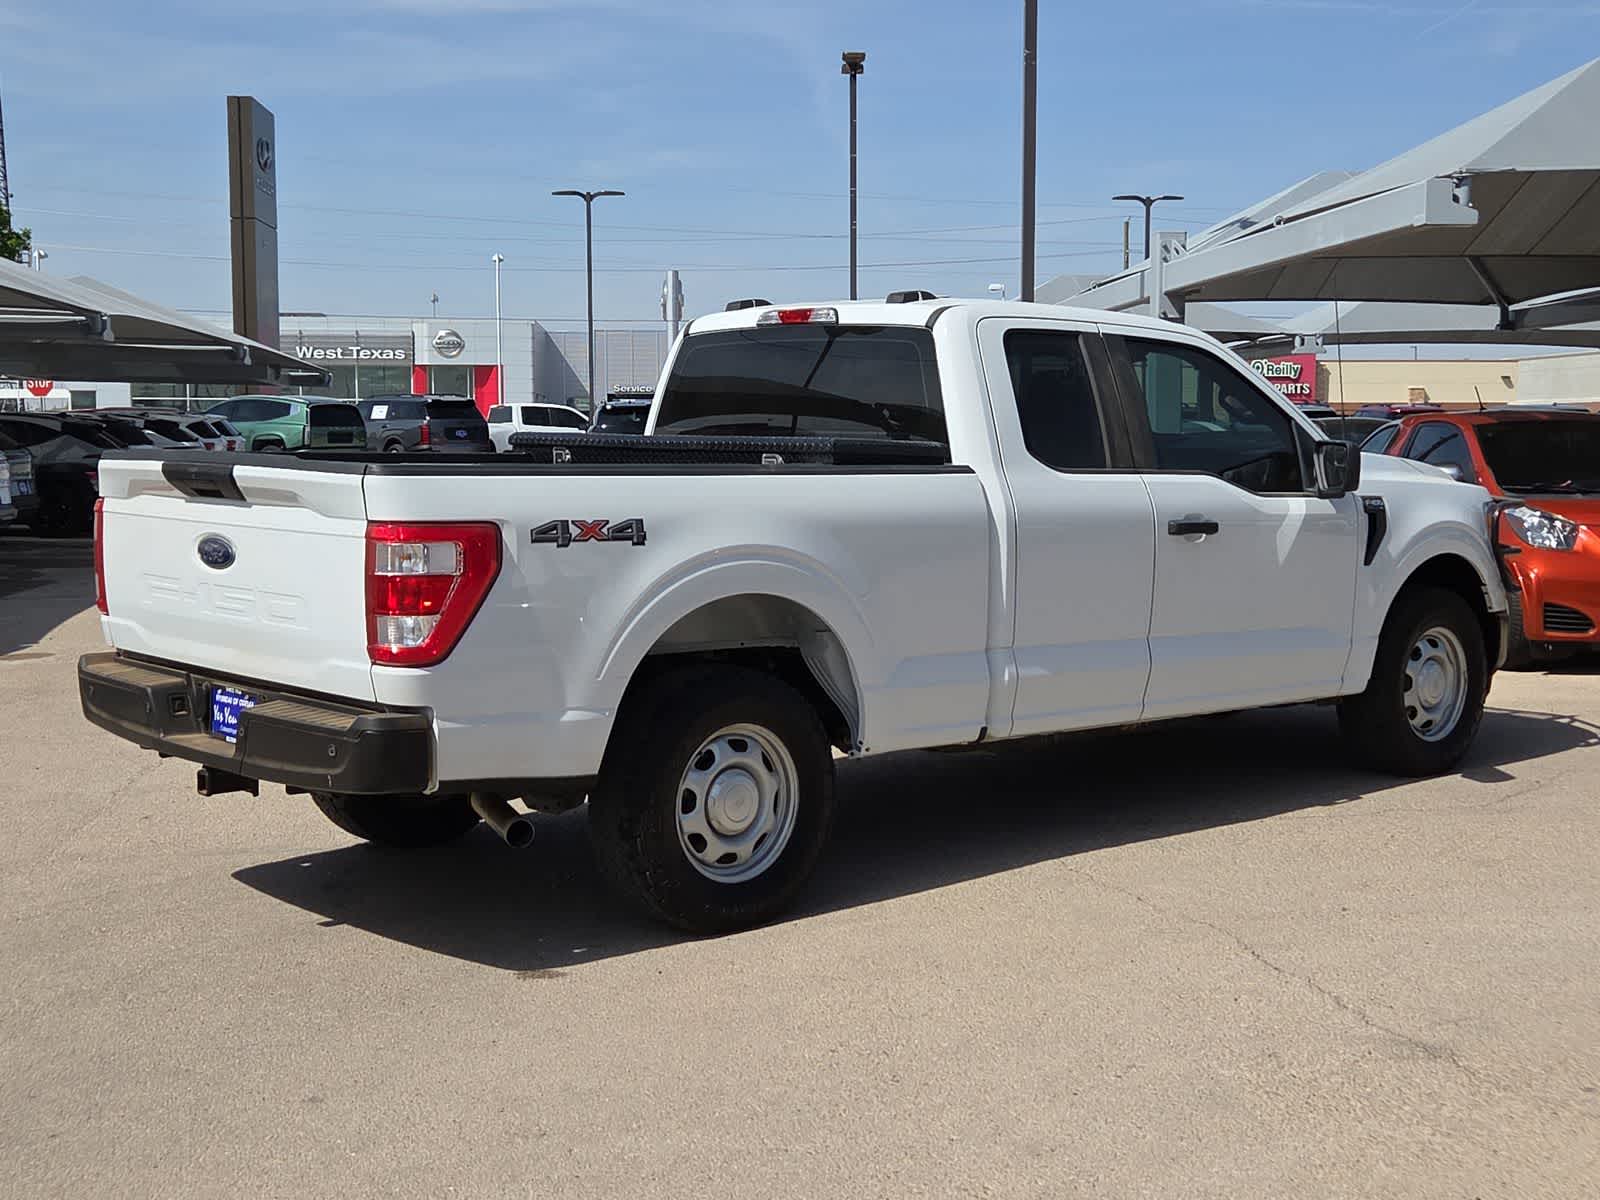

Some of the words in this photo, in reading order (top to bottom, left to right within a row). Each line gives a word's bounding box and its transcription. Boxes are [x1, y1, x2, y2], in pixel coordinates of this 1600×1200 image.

[296, 345, 346, 359] West
[348, 346, 406, 360] Texas
[1251, 359, 1300, 379] O'Reilly
[613, 384, 653, 393] Service
